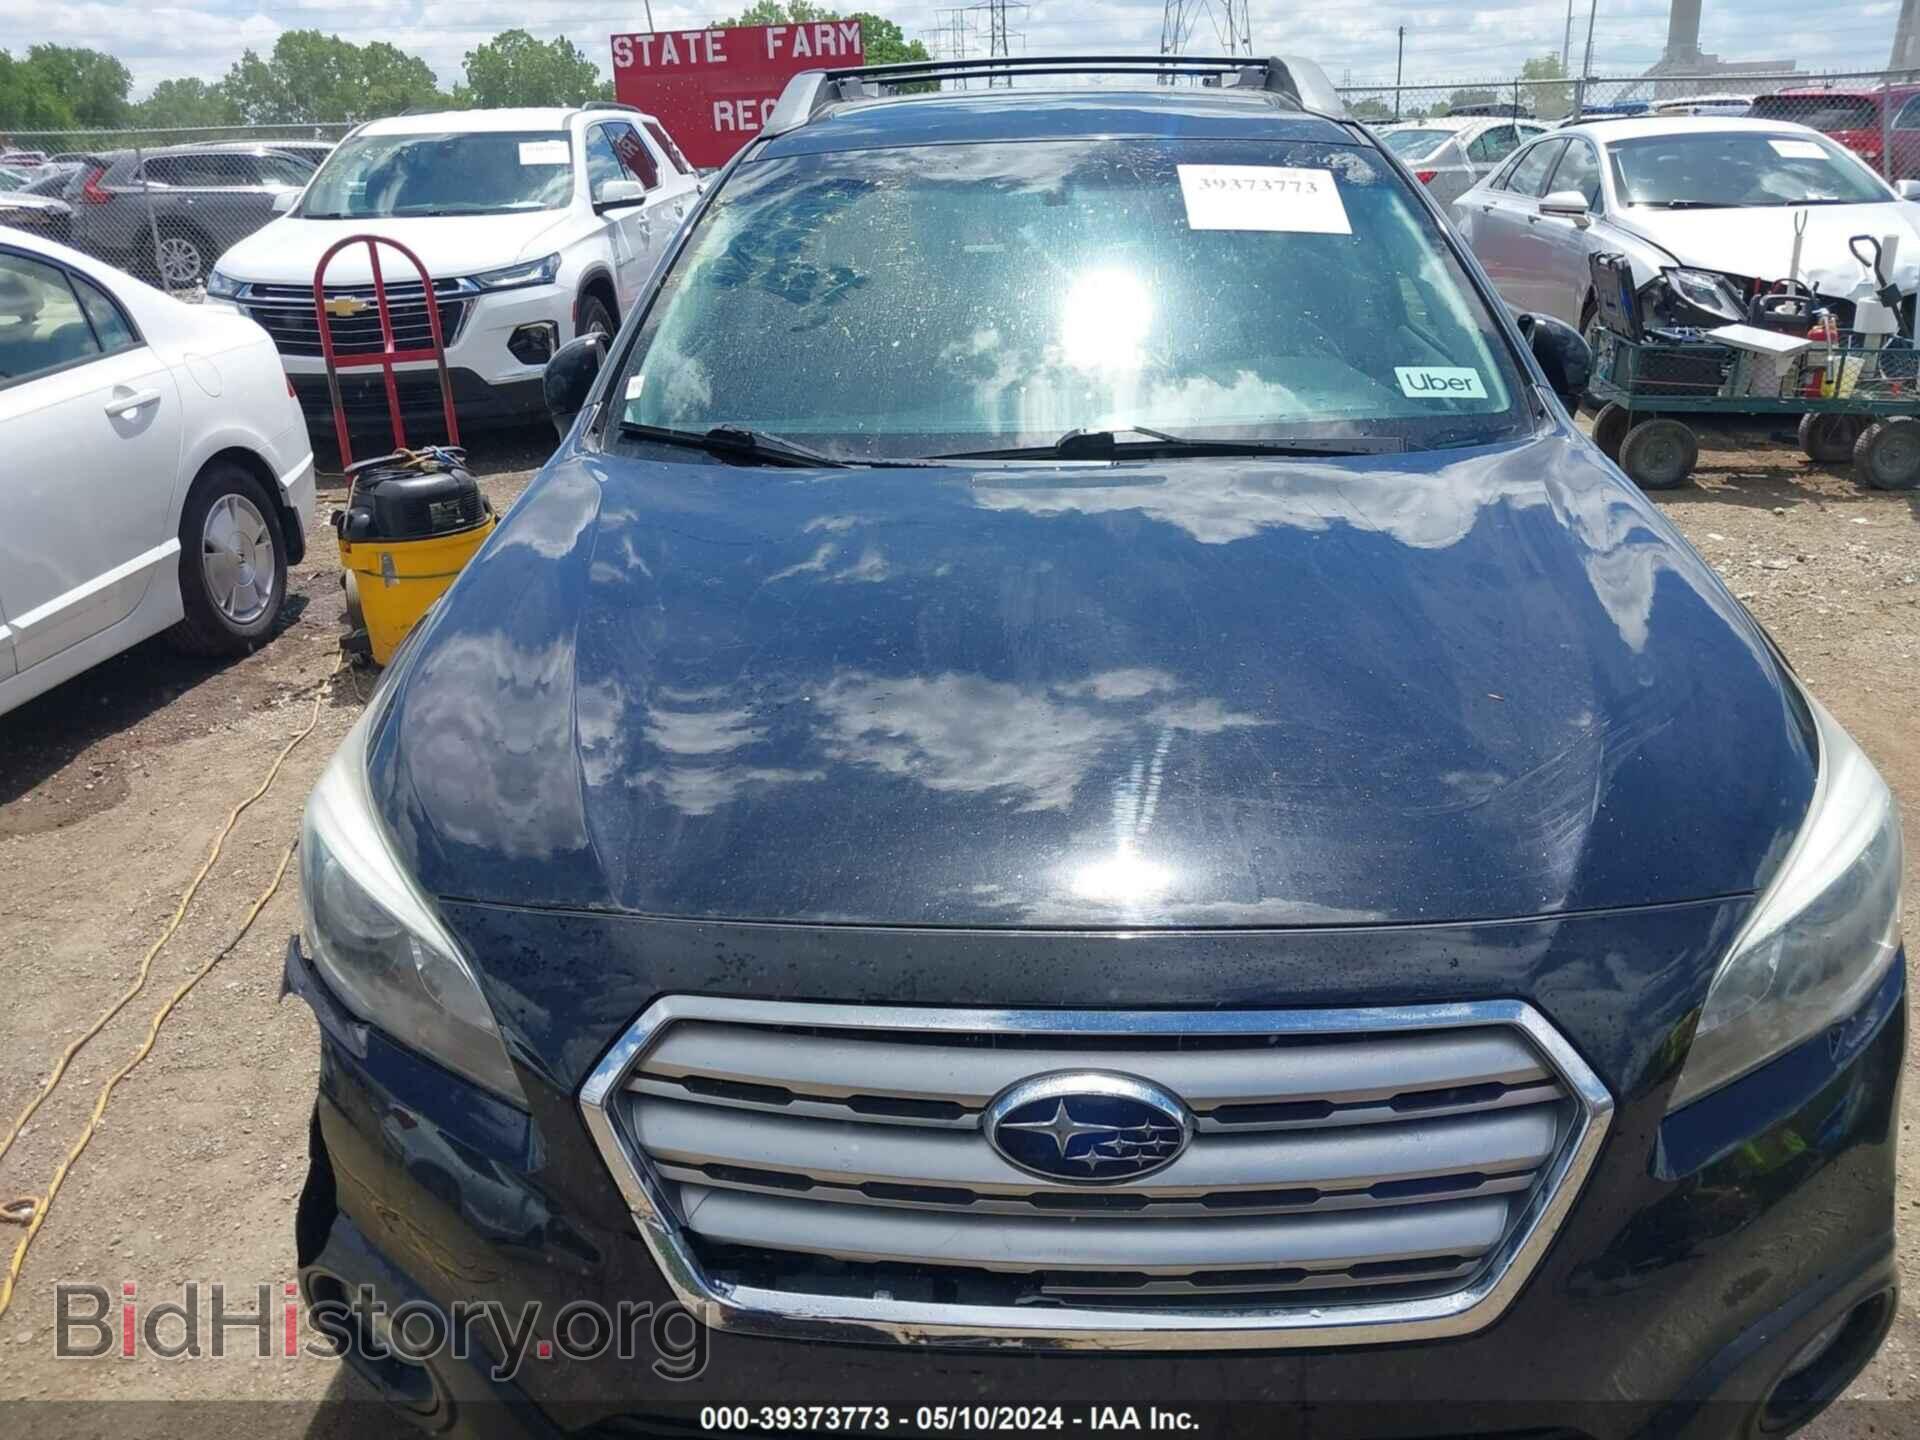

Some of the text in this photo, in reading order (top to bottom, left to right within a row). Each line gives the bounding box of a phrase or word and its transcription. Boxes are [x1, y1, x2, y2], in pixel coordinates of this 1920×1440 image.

[611, 22, 861, 68] STATE FARM
[1405, 373, 1472, 391] Uber
